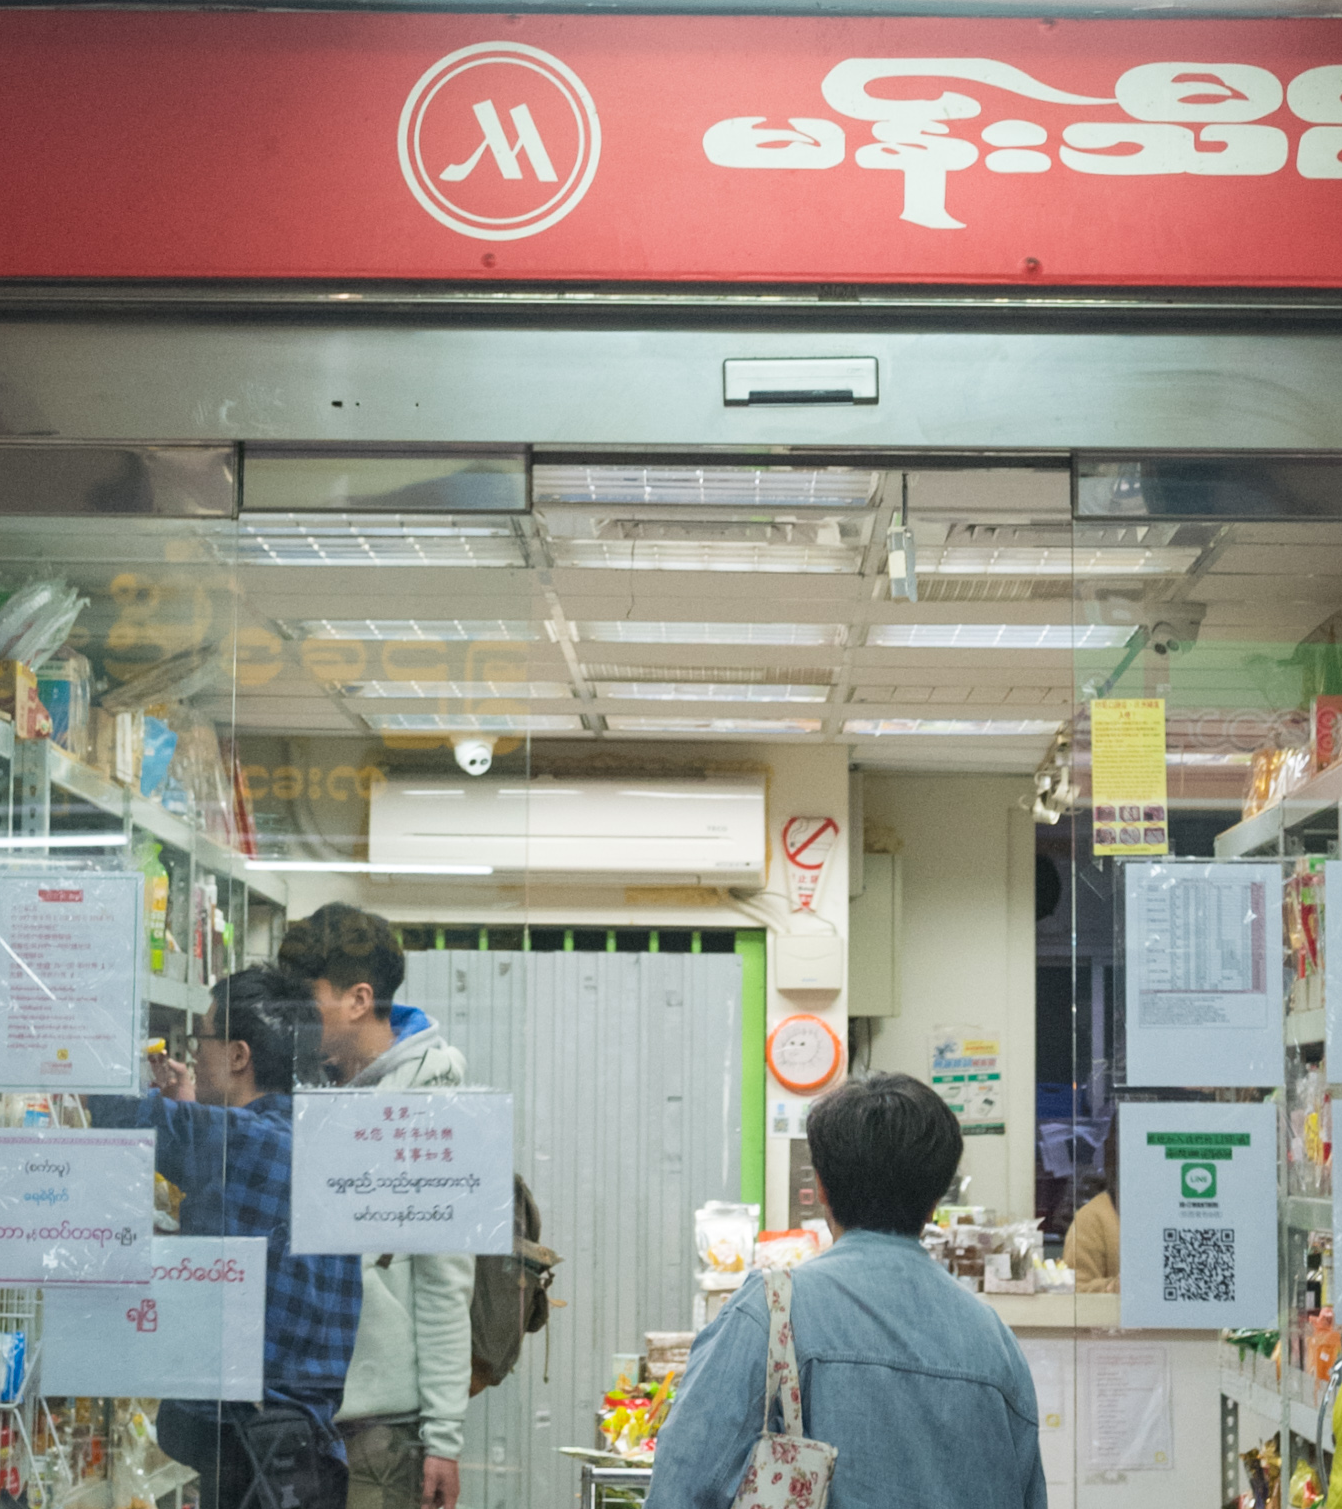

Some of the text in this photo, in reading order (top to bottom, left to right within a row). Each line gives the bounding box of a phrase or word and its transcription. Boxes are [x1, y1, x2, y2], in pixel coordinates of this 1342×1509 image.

[382, 1107, 426, 1121] 曼第一
[393, 1127, 453, 1141] 新年快樂
[394, 1148, 453, 1162] 萬事如意
